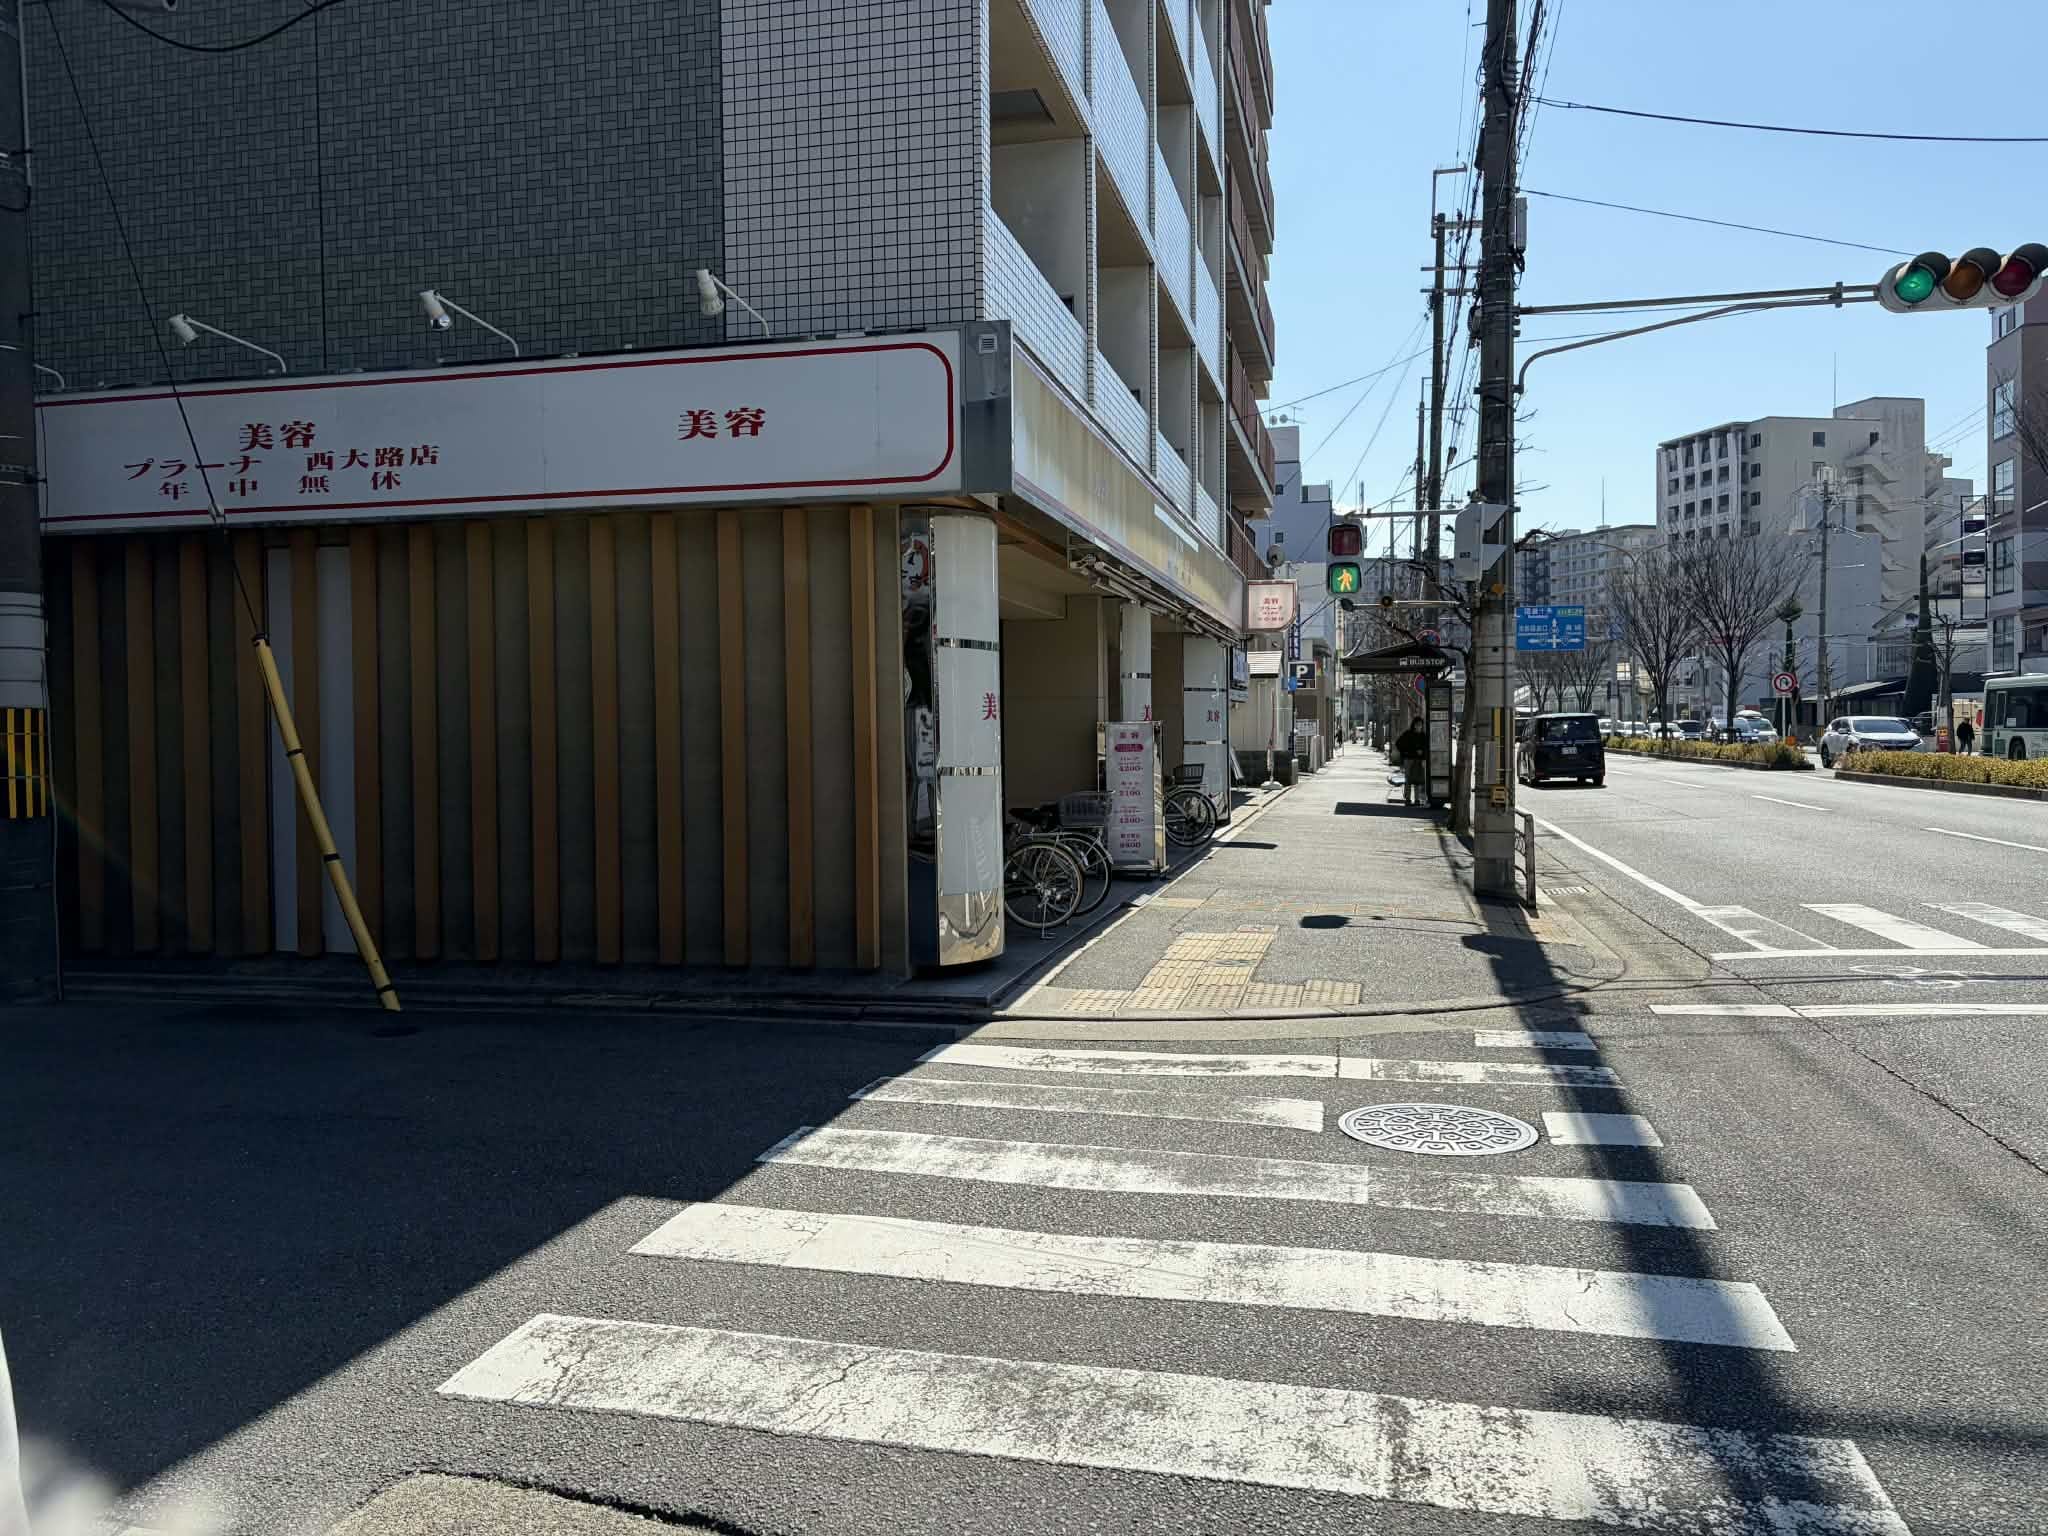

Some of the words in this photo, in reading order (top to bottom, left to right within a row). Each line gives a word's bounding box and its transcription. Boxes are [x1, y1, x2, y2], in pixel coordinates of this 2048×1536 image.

[240, 420, 316, 451] 美容
[678, 407, 766, 440] 美容
[123, 455, 263, 481] プラーナ
[306, 444, 441, 471] 西大路店
[159, 470, 402, 500] 年中無休
[1296, 665, 1308, 679] P
